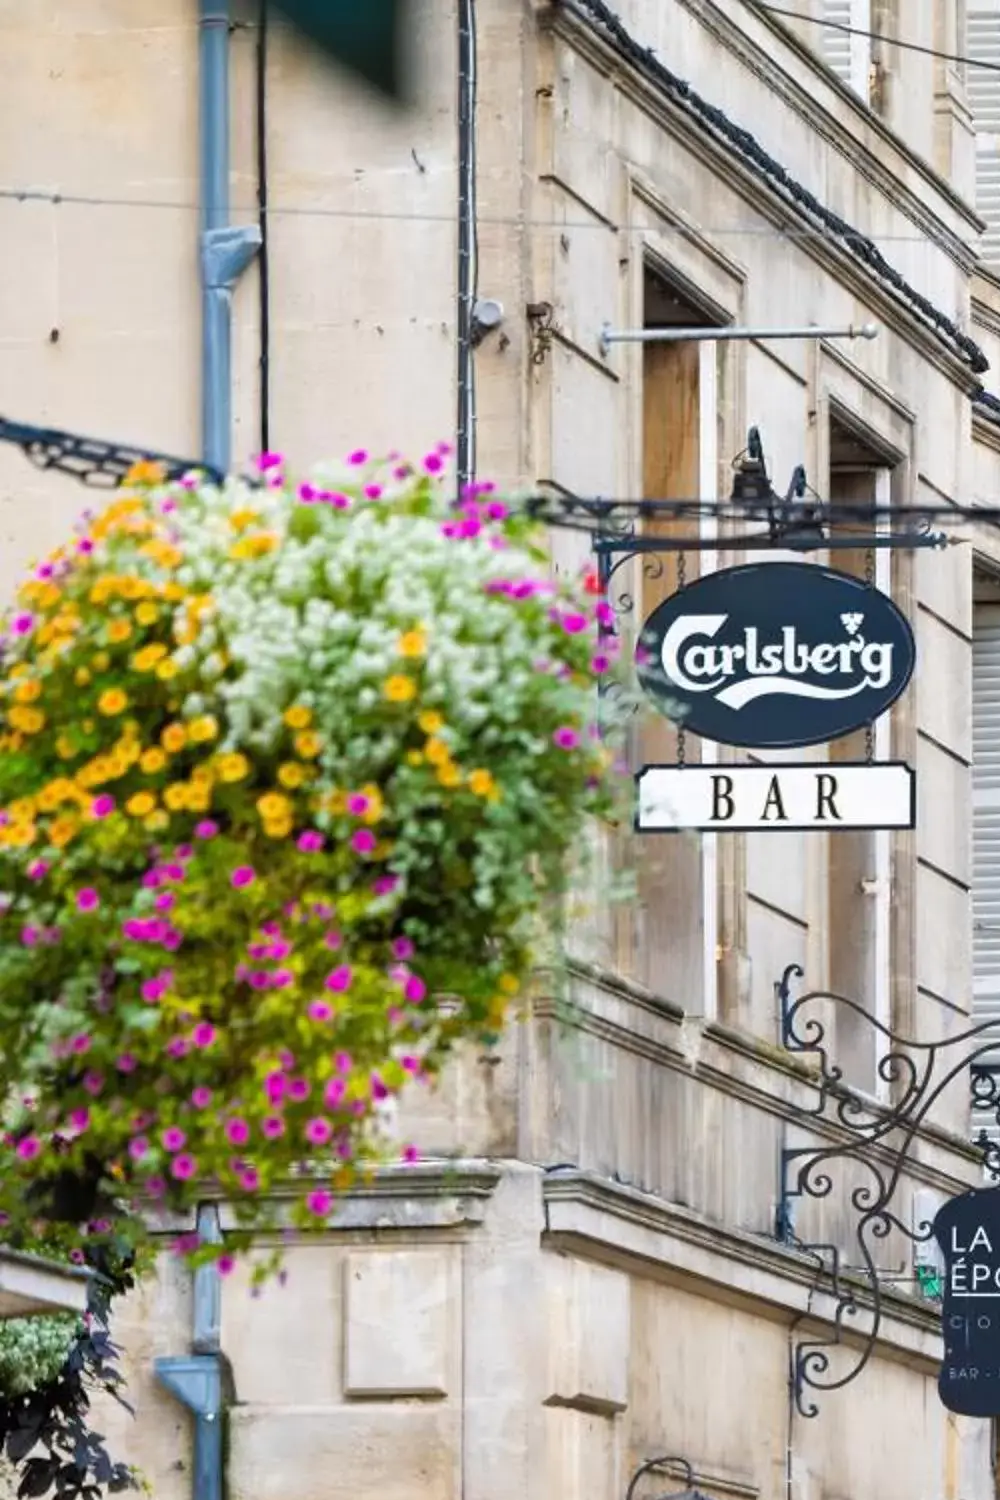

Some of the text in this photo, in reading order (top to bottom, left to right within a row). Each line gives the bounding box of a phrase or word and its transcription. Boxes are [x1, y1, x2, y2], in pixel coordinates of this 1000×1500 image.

[661, 612, 894, 702] Carlsberg
[708, 773, 843, 821] BAR
[951, 1225, 993, 1253] LA
[949, 1366, 980, 1380] BAR
